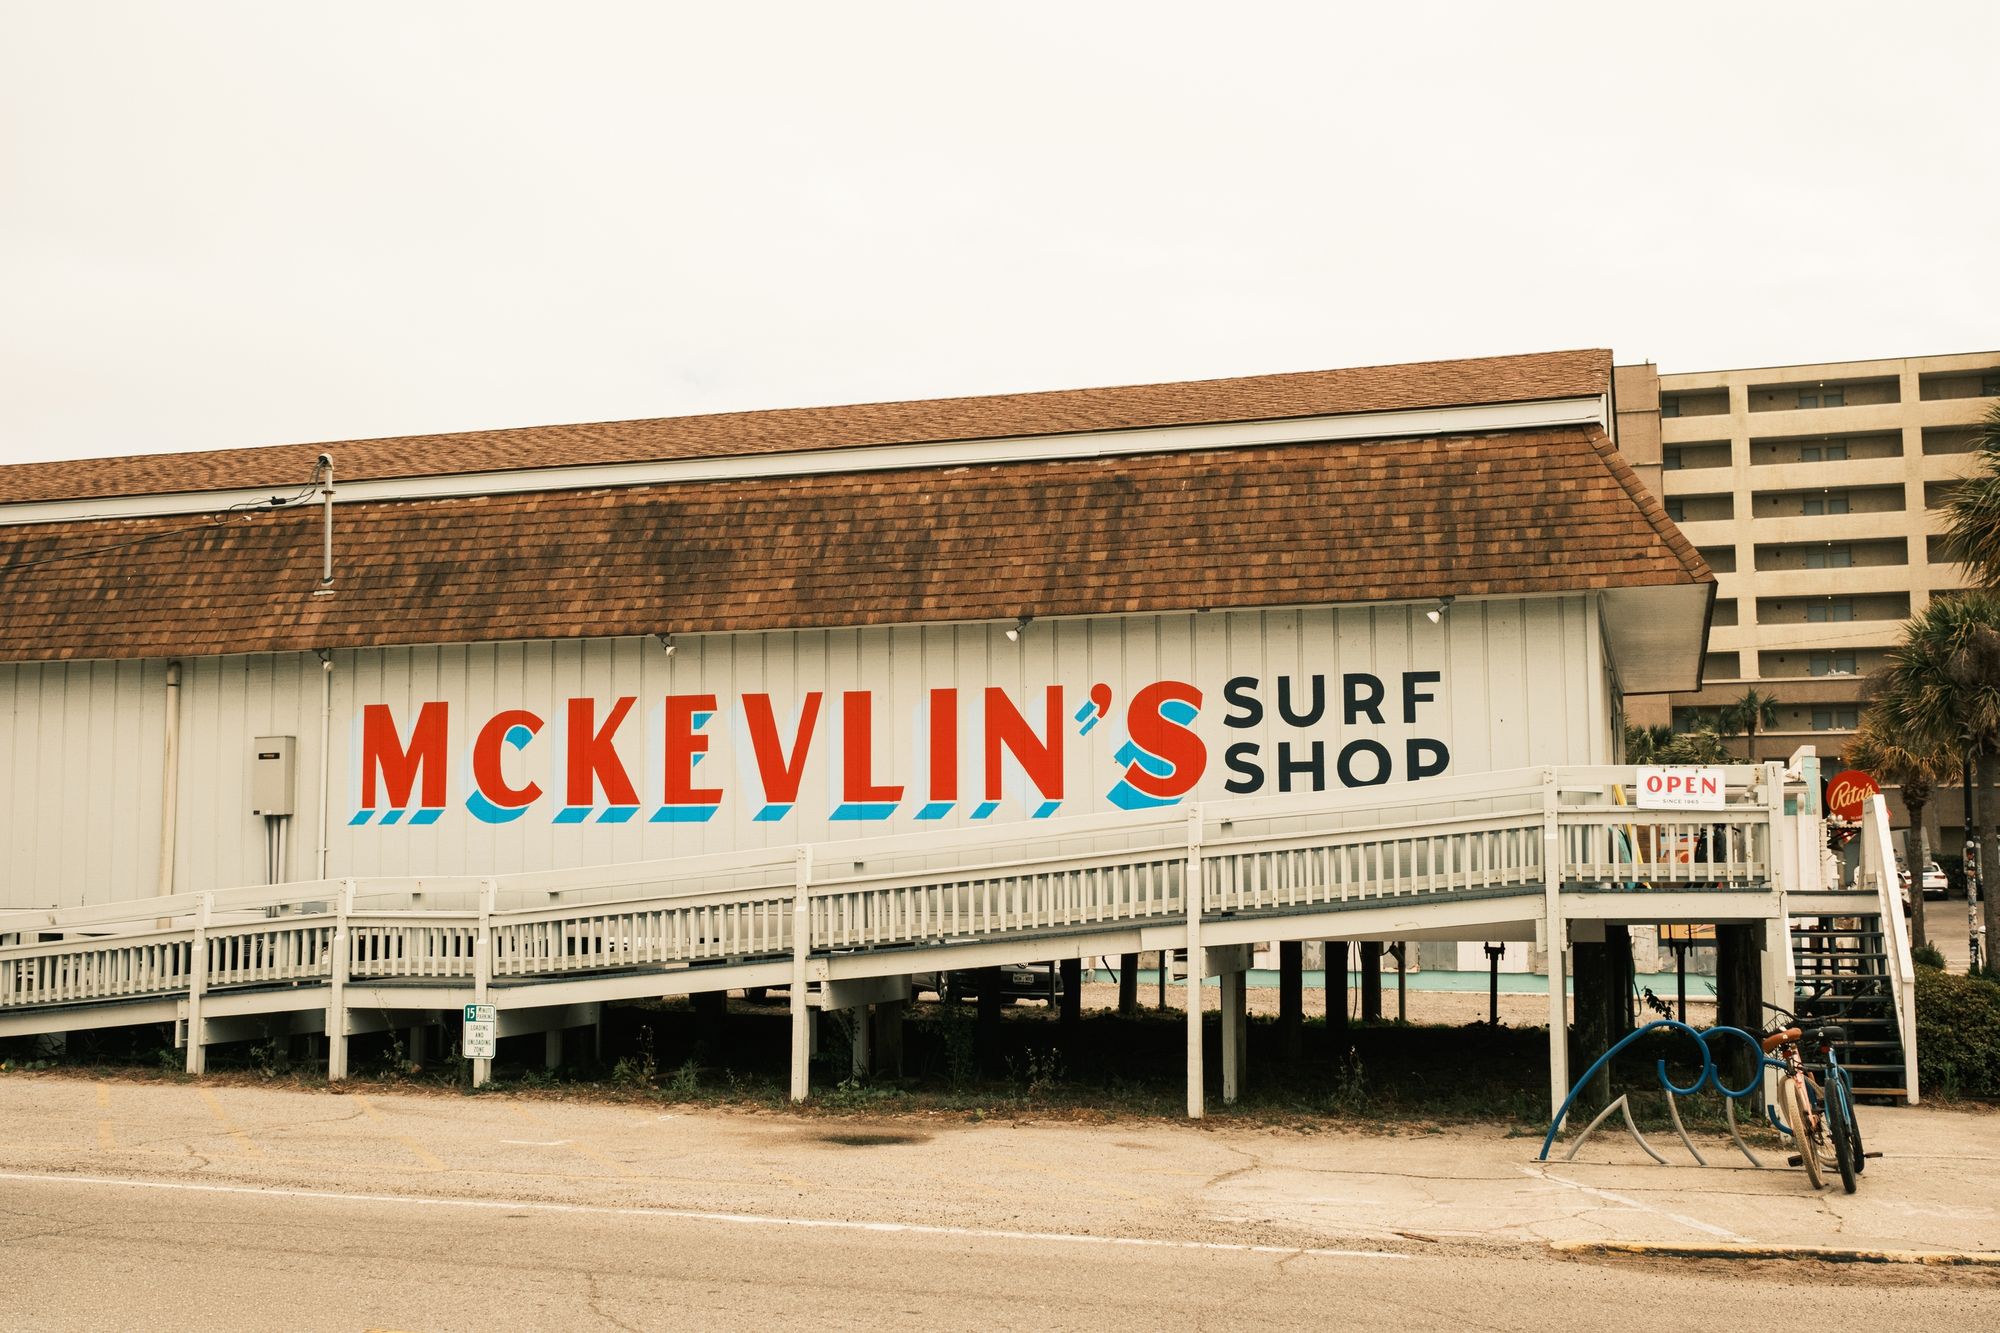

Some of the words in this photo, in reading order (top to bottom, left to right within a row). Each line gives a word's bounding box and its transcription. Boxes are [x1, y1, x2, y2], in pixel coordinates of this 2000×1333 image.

[1223, 671, 1441, 729] SURF
[1224, 738, 1450, 794] SHOP
[1646, 775, 1717, 794] OPEN
[1830, 780, 1876, 811] Rita's
[467, 1007, 475, 1018] 15
